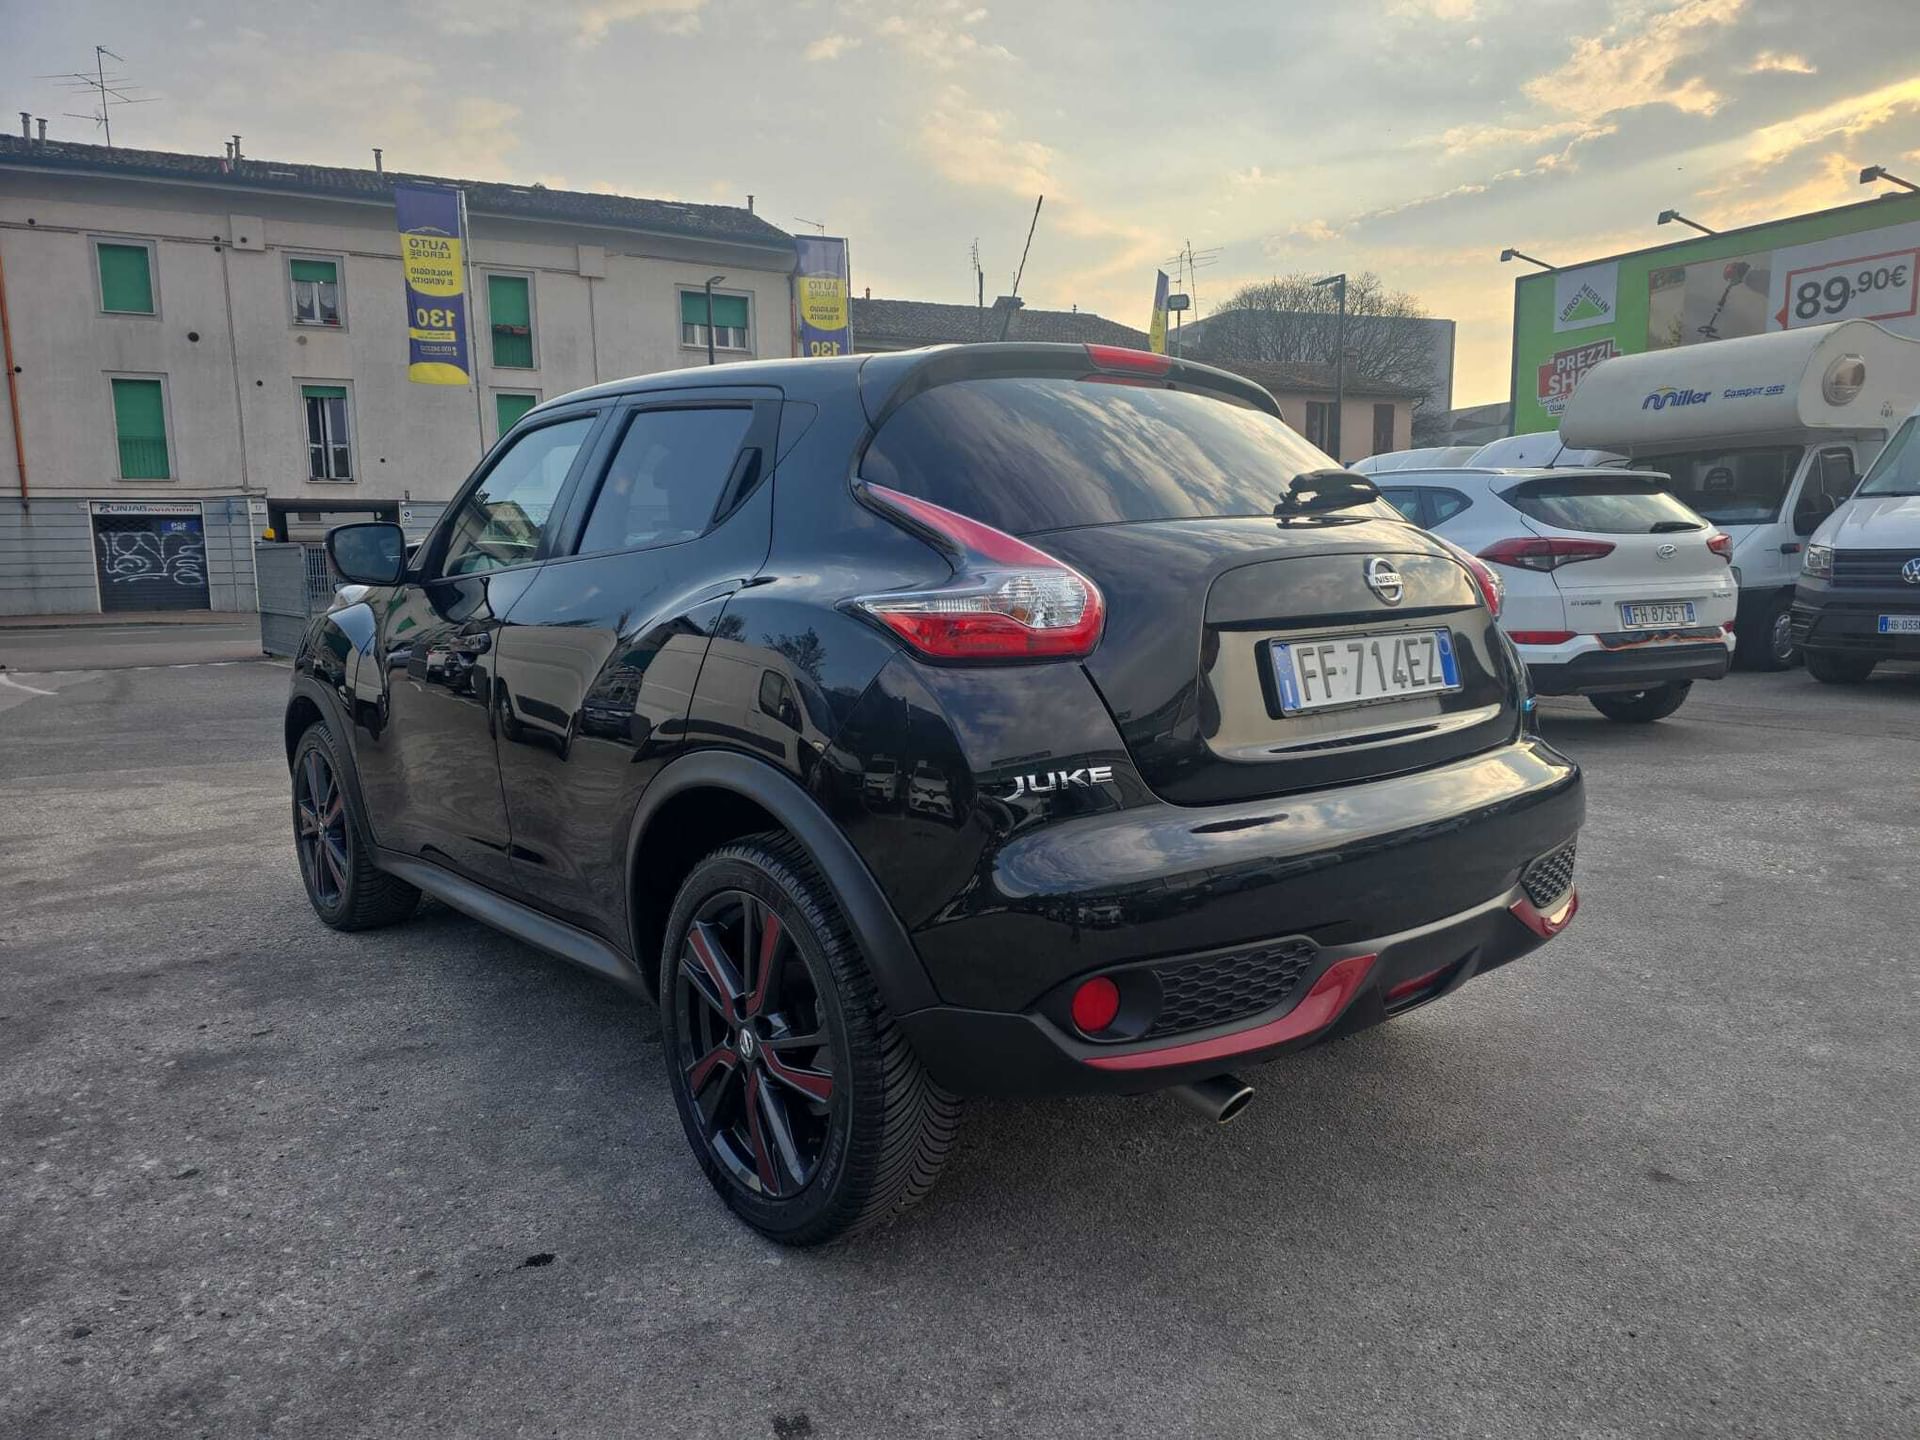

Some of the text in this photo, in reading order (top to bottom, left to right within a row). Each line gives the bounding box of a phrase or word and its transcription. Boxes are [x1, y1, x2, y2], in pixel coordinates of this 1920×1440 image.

[1560, 283, 1610, 321] LEROY MERLIN
[1556, 342, 1612, 373] PREZZI
[1297, 645, 1337, 701] FF
[1347, 637, 1442, 695] 714EZ
[1002, 766, 1113, 802] JUKE
